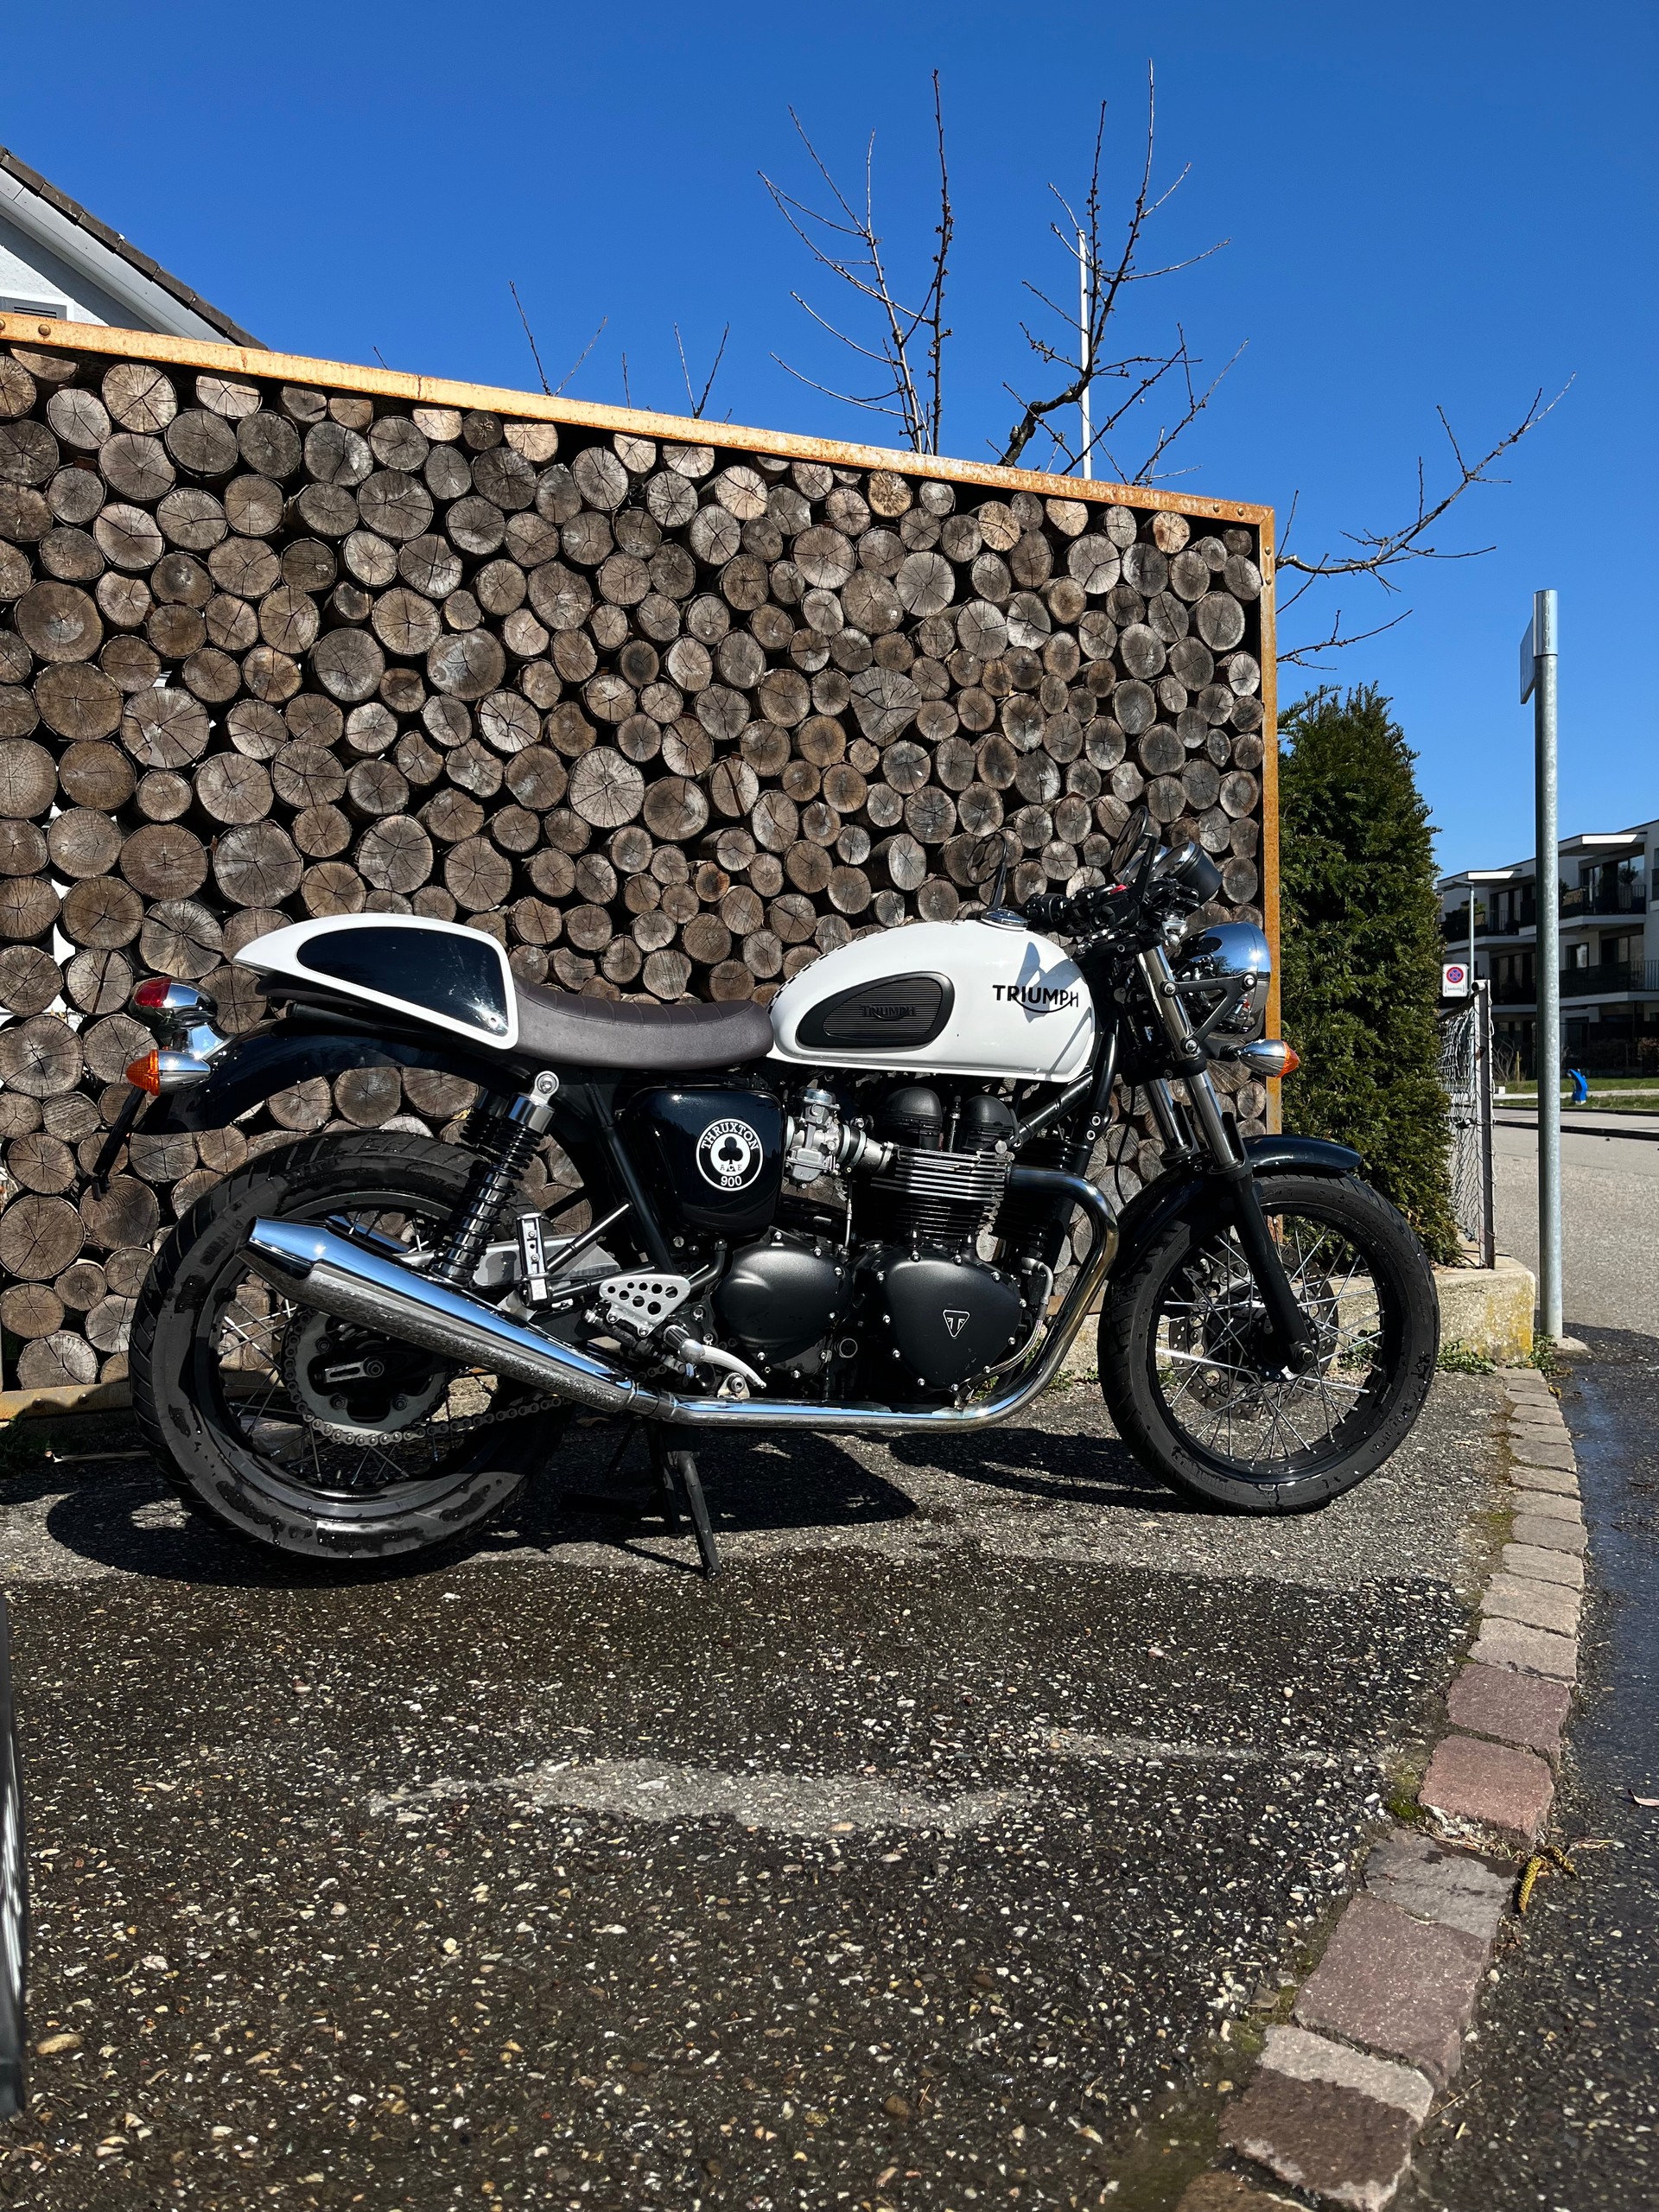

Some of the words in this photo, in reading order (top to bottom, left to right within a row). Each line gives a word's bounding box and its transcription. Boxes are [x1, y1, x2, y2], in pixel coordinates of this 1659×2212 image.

[992, 984, 1079, 1012] TRIUMPH
[860, 1004, 916, 1019] TRIUMPH
[701, 1122, 760, 1150] THRUXTON
[721, 1175, 742, 1187] 900
